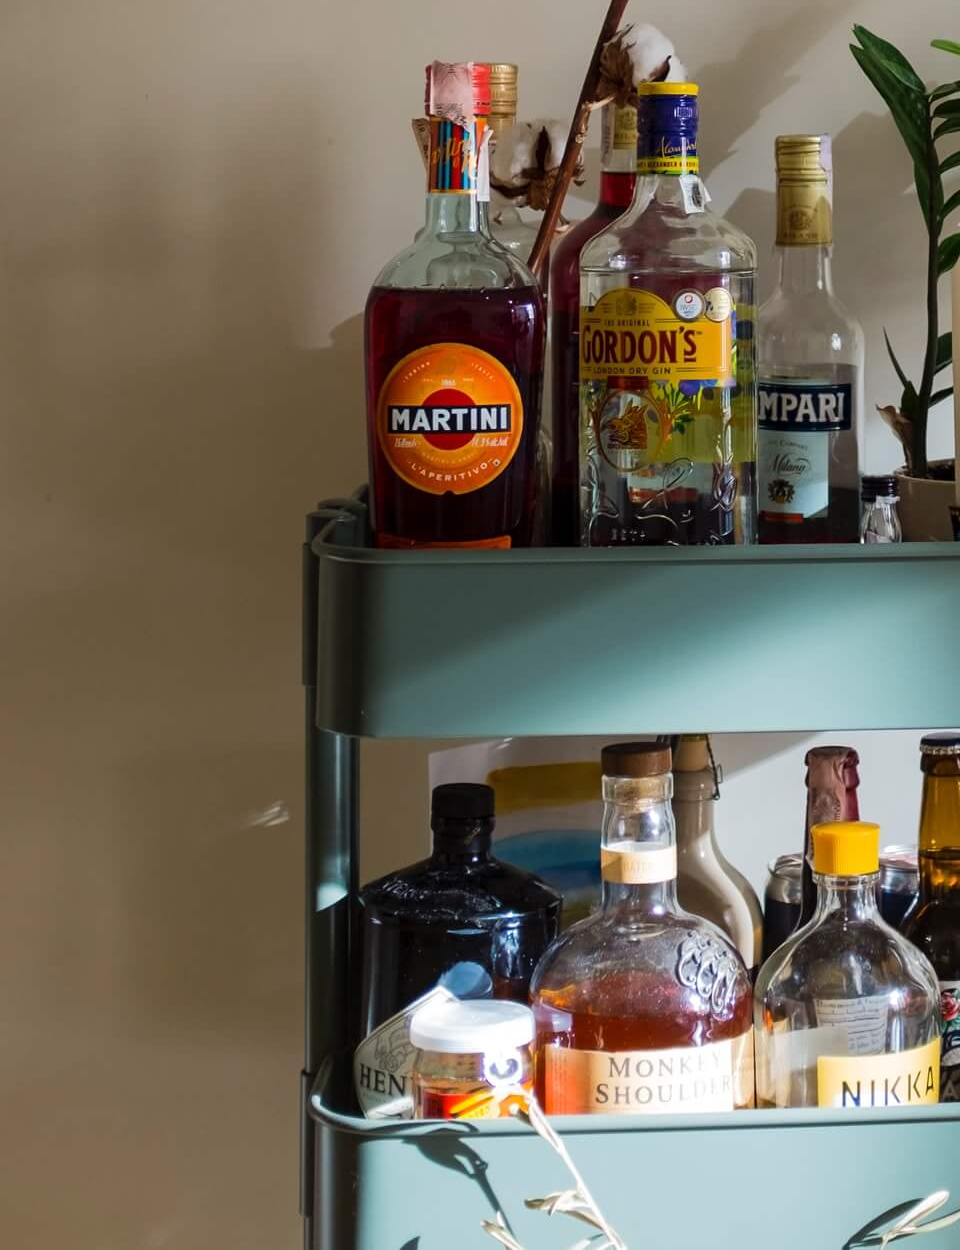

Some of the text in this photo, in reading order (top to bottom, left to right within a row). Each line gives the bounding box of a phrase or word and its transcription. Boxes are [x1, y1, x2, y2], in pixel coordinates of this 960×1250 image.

[583, 325, 697, 364] GORDON'S
[592, 366, 671, 375] LONDON DRY GIN
[391, 406, 508, 431] MARTINI
[411, 461, 488, 482] L'APERITIVO
[608, 1051, 721, 1078] MONKEY
[595, 1075, 730, 1104] SHOULDER
[842, 1066, 934, 1107] NIKKA
